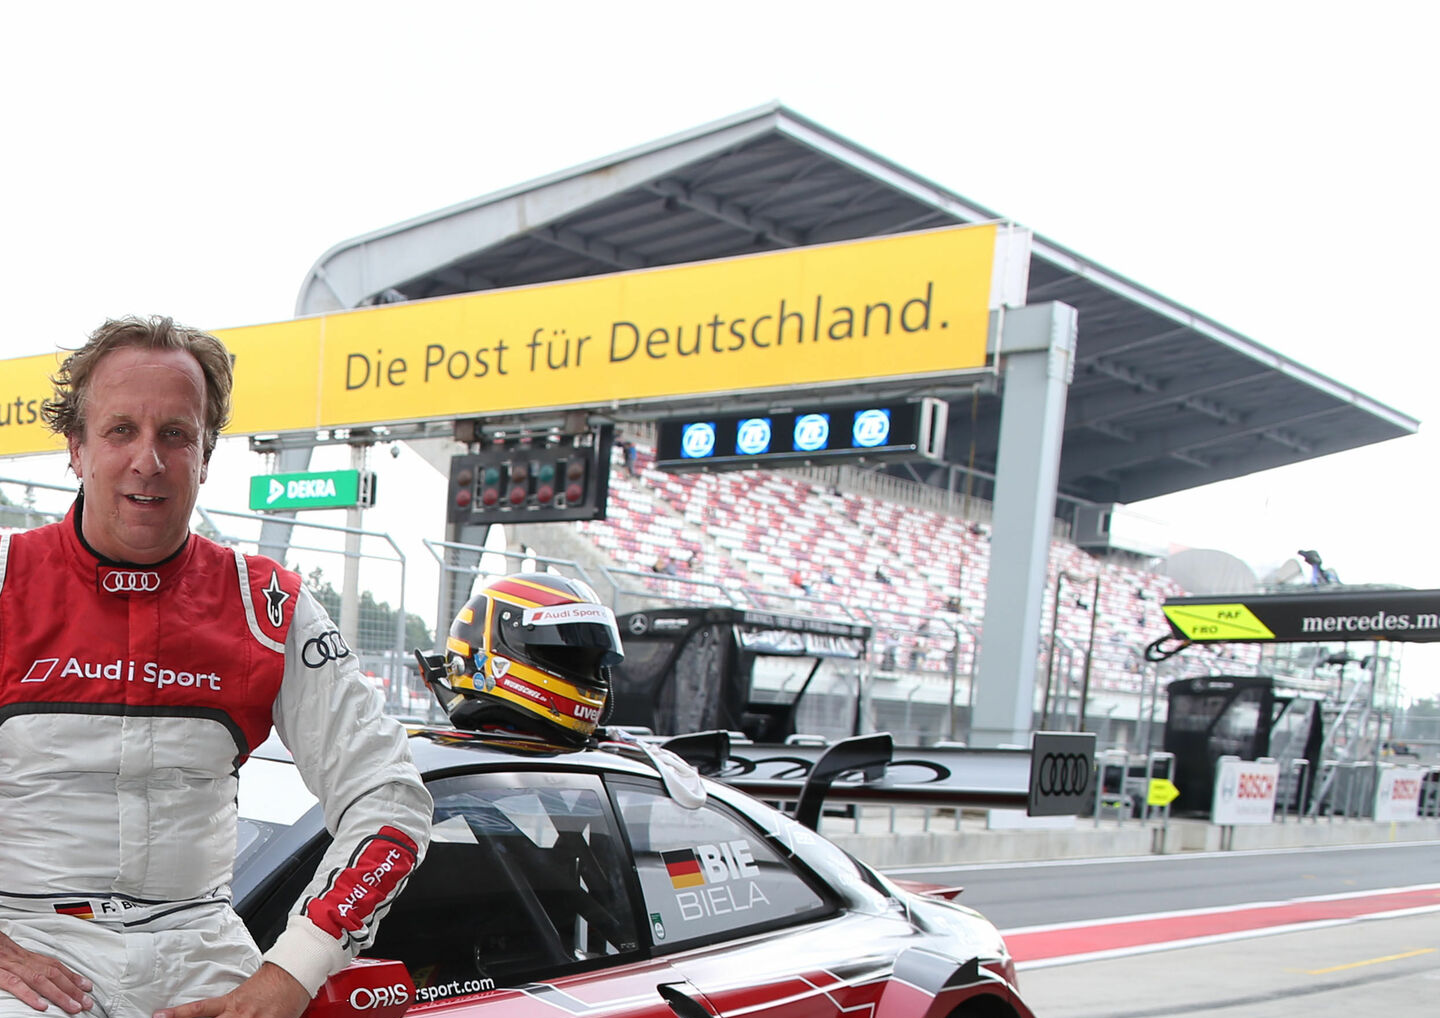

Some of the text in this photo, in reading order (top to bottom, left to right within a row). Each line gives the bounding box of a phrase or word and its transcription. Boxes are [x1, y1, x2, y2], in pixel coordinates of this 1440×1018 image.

[345, 281, 950, 391] Die Post für Deutschland.
[286, 475, 337, 500] DEKRA
[544, 609, 601, 620] Audi Sport
[1302, 610, 1440, 633] mercedes.m
[60, 657, 221, 693] Audi Sport
[696, 839, 760, 884] BIE
[336, 848, 401, 917] Audi Sport
[675, 880, 771, 921] BIELA
[349, 983, 409, 1010] ORIS
[415, 977, 496, 1002] rsport.com
